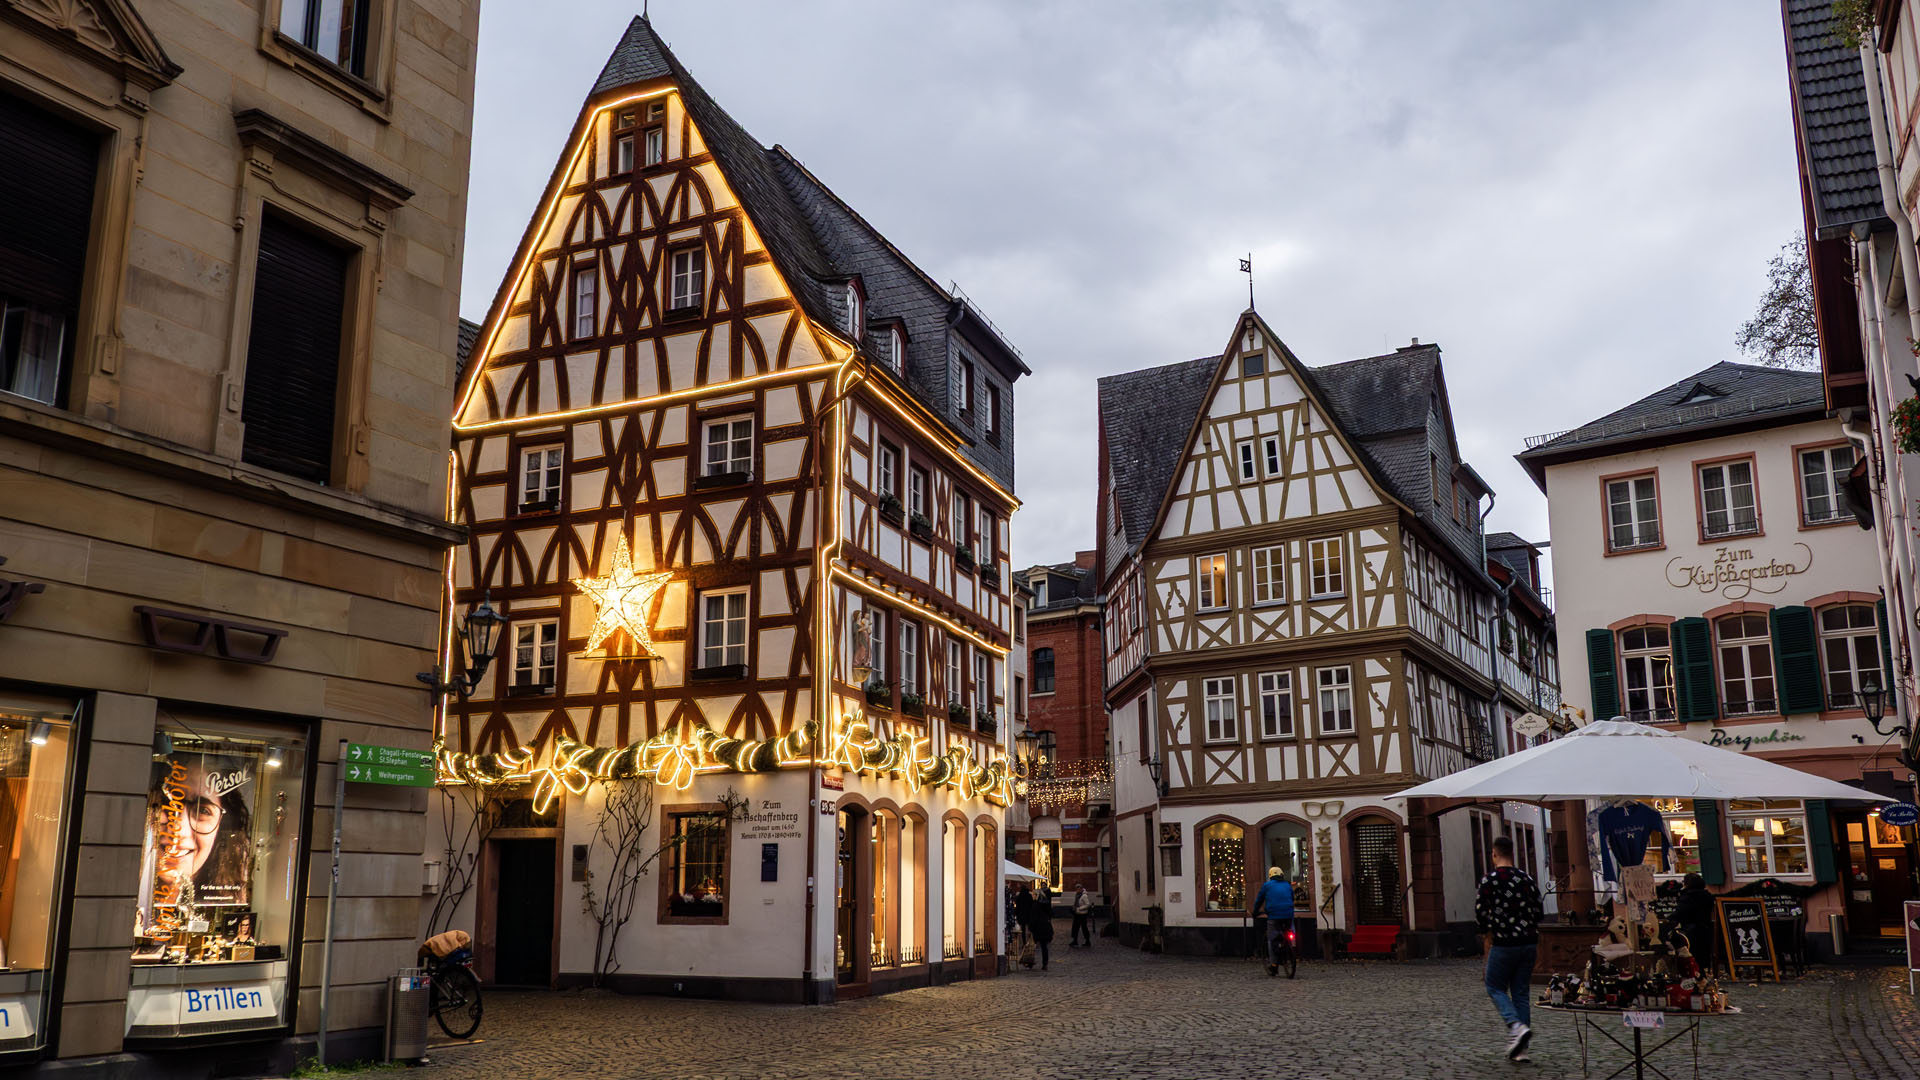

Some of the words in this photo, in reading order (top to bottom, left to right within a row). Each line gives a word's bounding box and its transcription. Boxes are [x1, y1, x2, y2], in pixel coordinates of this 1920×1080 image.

[1714, 547, 1754, 564] Zum
[1702, 728, 1805, 751] Bergschön
[205, 764, 252, 797] Persol
[762, 800, 782, 809] Zum
[743, 811, 798, 824] Aschaffenberg
[185, 987, 262, 1013] Brillen
